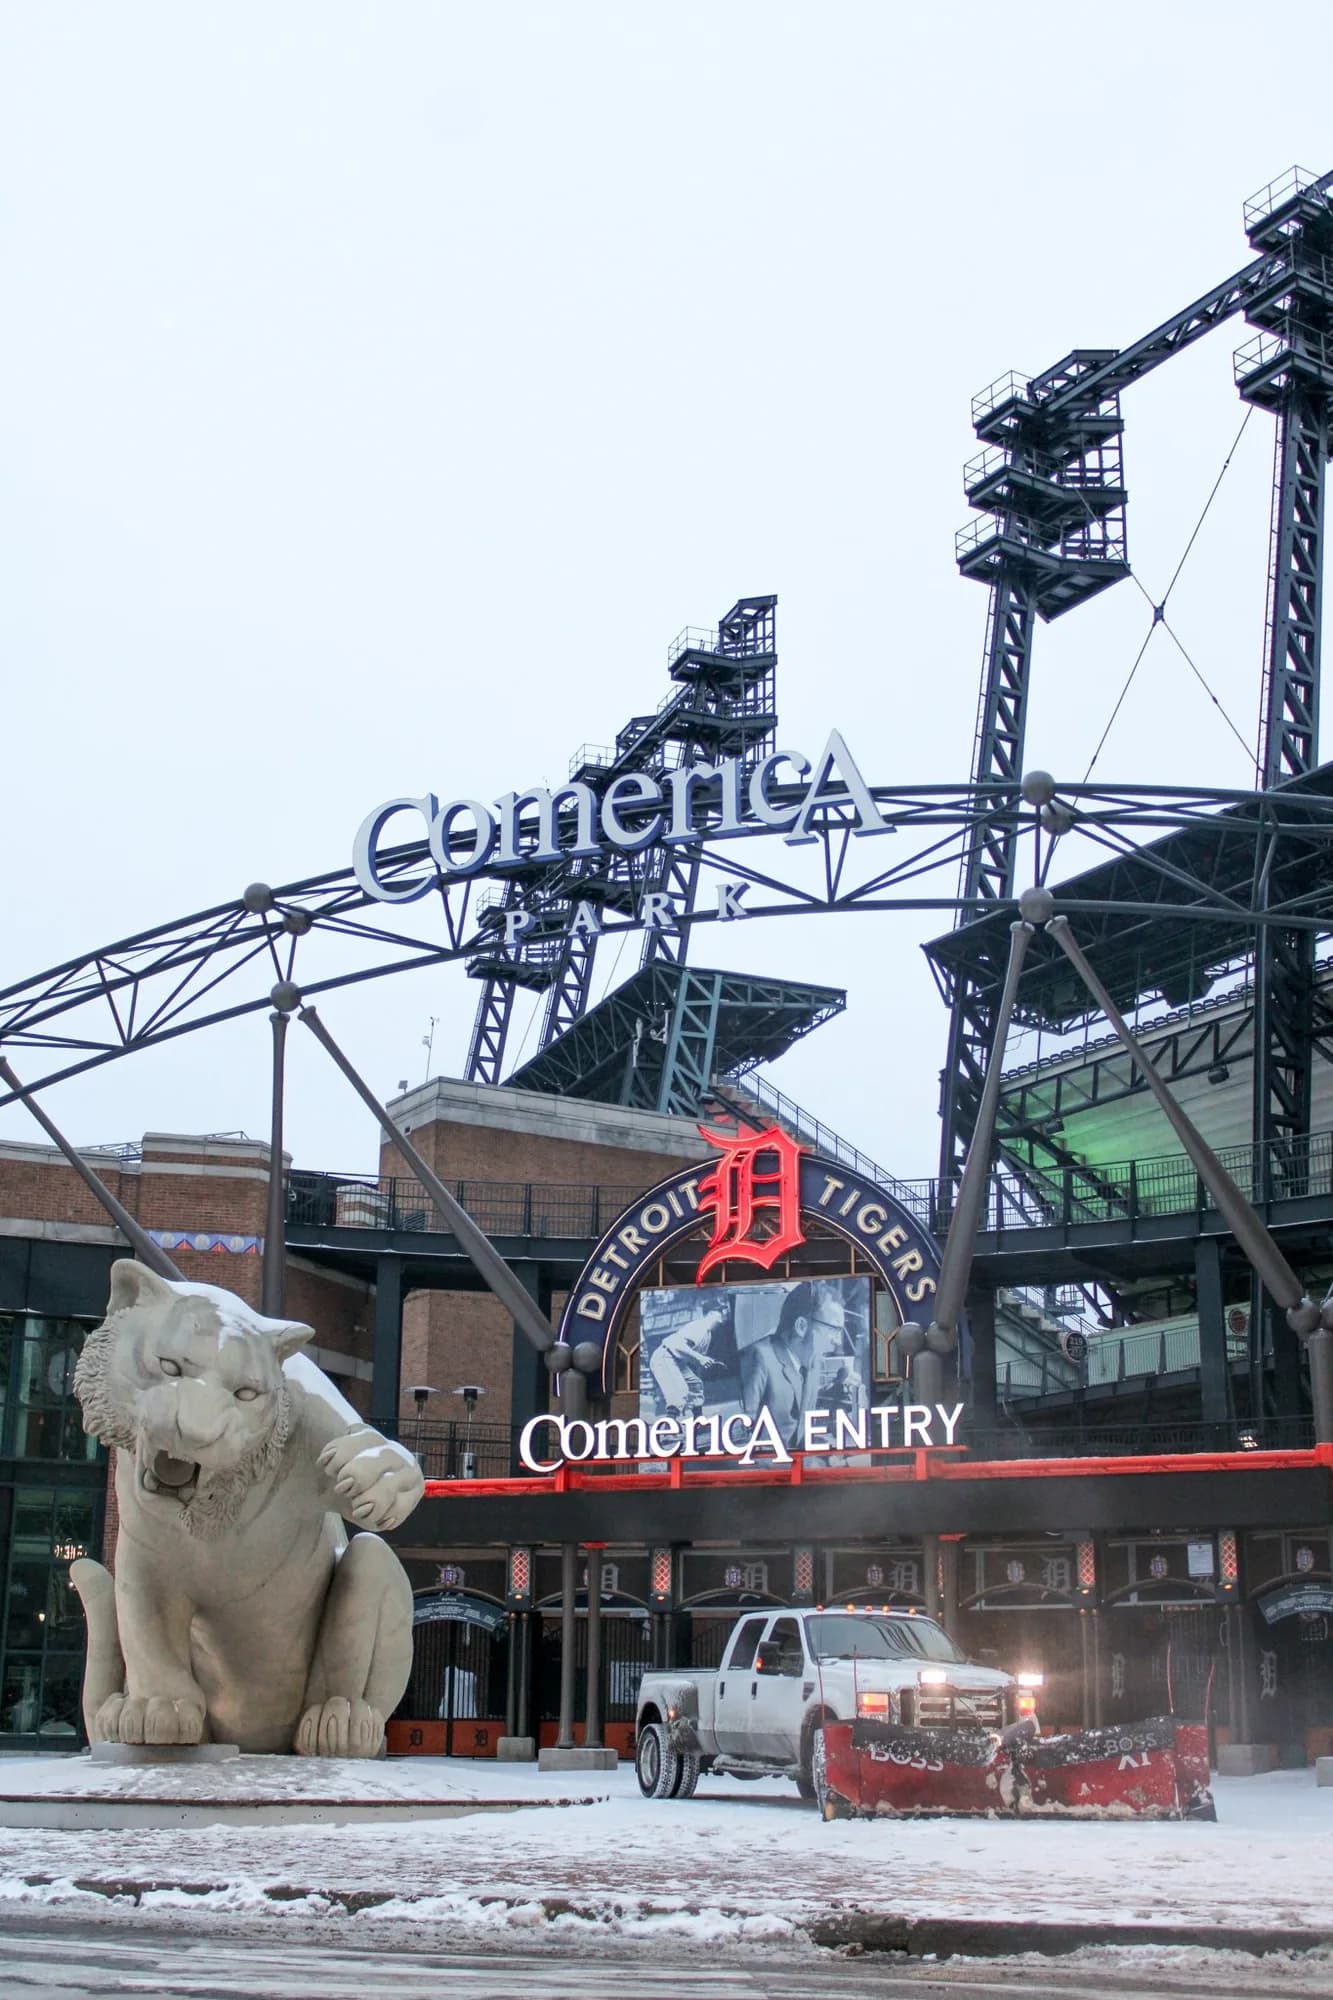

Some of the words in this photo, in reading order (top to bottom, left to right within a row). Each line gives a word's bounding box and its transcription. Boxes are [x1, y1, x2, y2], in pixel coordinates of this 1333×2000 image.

[504, 881, 751, 947] PARK
[575, 1177, 701, 1322] DETROIT
[817, 1174, 937, 1303] TIGERS
[804, 1403, 964, 1452] ENTRY
